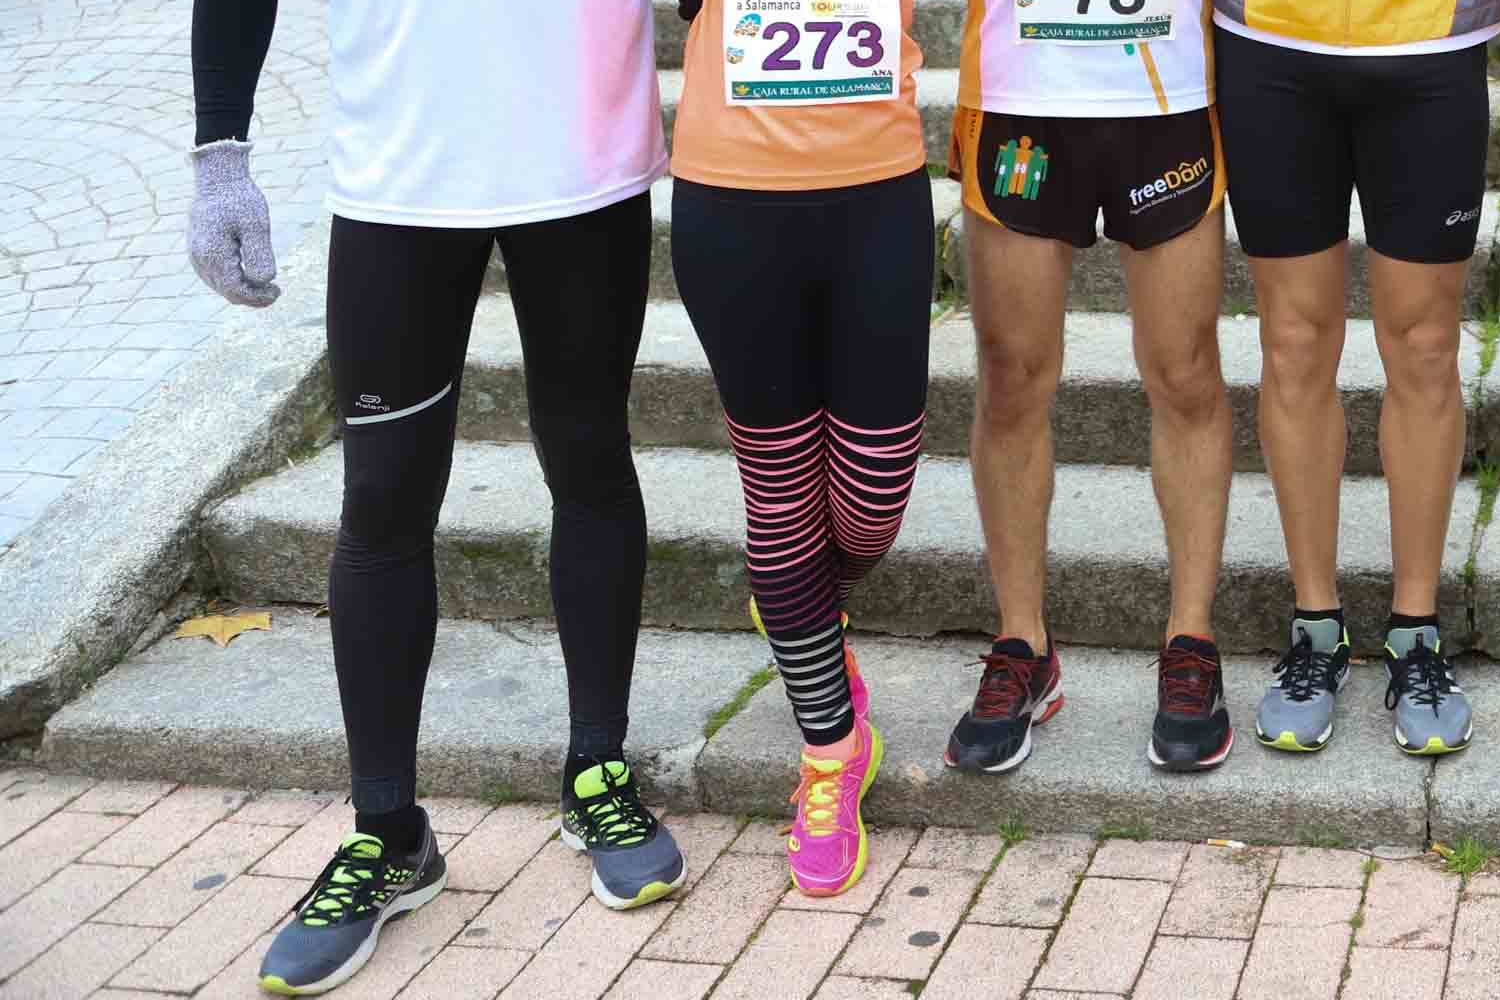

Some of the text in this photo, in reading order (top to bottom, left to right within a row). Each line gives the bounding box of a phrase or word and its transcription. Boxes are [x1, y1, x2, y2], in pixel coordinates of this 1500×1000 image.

[736, 0, 801, 11] a Salamanca
[1039, 25, 1169, 38] CAJA RURAL DE SALAMANCA
[761, 21, 885, 71] 273
[752, 81, 891, 98] CAJA RURAL DE SALAMANCA
